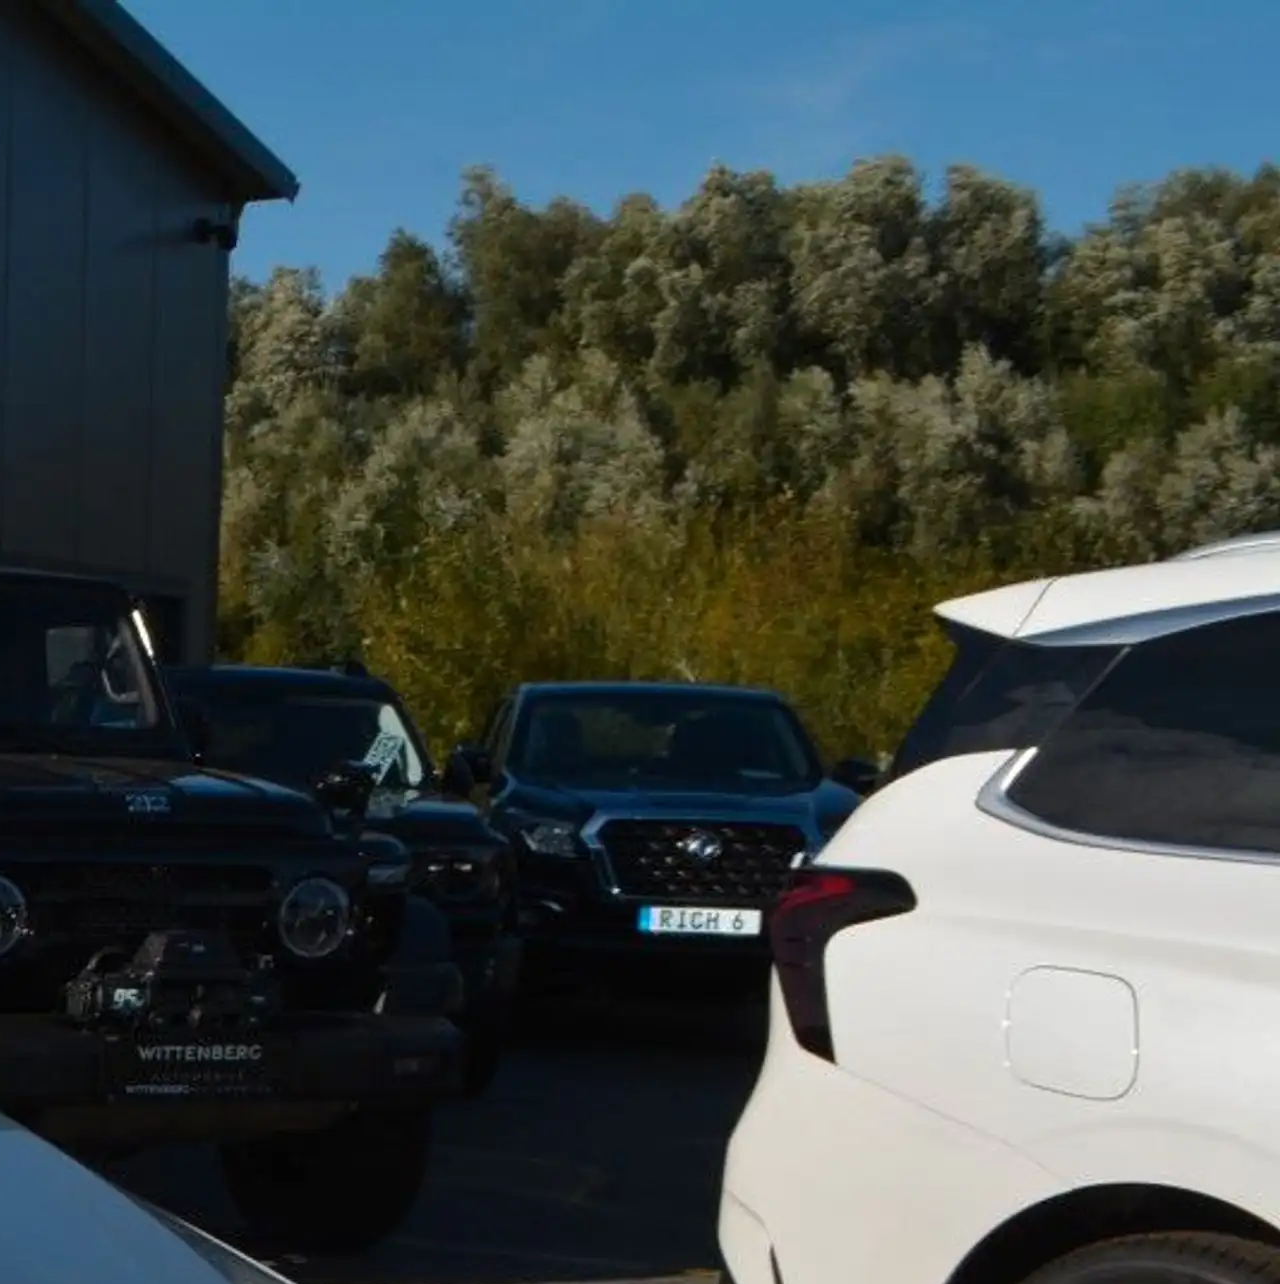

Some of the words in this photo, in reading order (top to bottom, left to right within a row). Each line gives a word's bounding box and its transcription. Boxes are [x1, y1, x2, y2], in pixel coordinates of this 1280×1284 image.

[659, 910, 719, 930] RICH
[732, 913, 744, 930] 6
[137, 1044, 263, 1062] WITTENBERG
